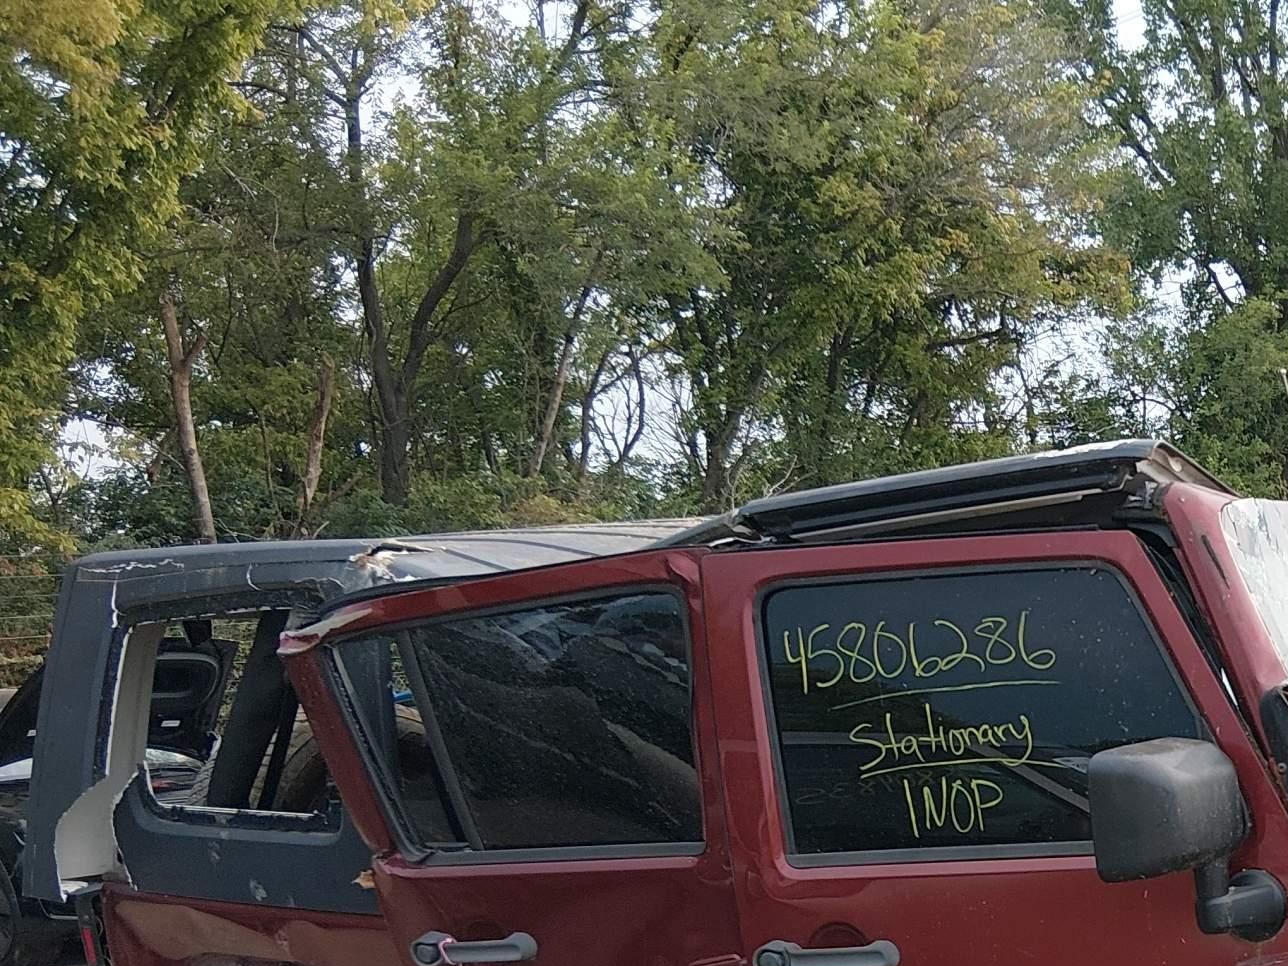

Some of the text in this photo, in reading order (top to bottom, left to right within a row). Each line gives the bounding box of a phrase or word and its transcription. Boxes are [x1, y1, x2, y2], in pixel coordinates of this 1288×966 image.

[783, 610, 1057, 695] 45806286
[848, 703, 1034, 770] Stationary
[903, 777, 1003, 838] INOP
